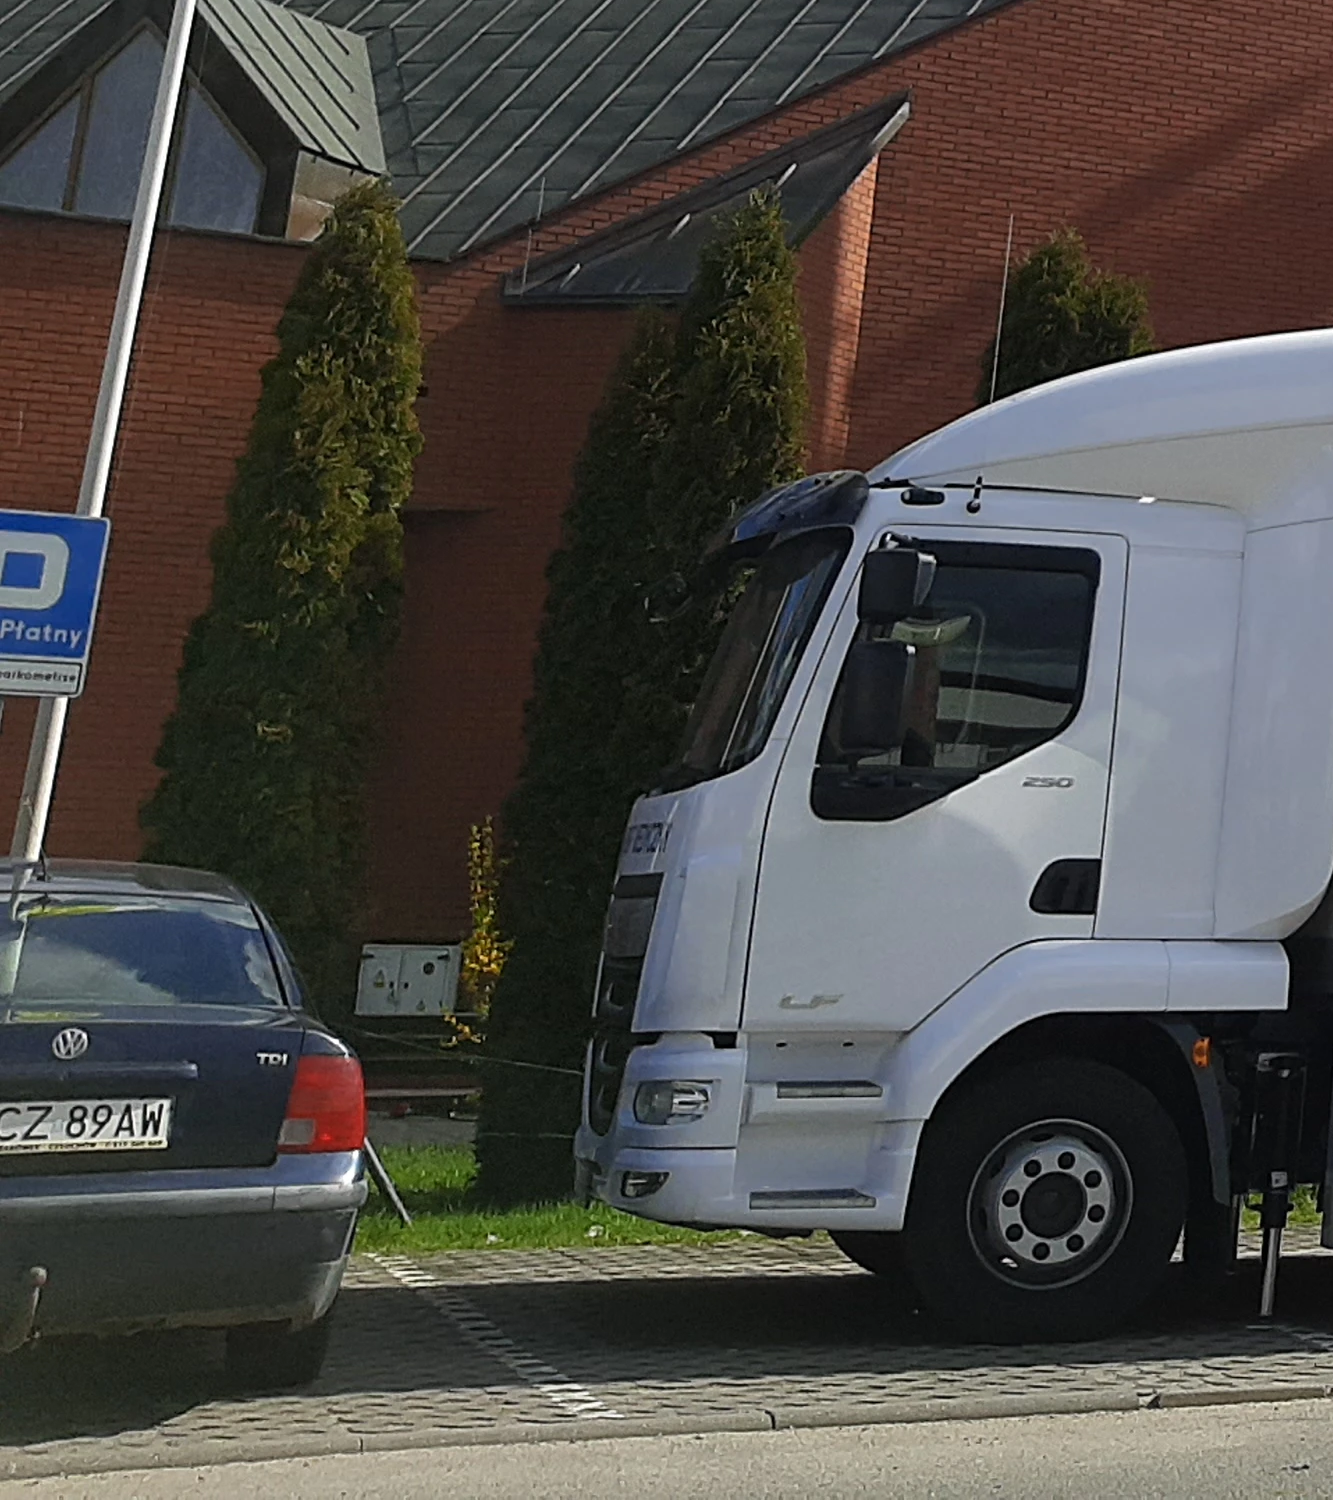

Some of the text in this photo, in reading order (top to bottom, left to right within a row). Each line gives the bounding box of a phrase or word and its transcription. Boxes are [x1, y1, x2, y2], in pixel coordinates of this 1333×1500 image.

[0, 618, 83, 649] Płatny
[1022, 776, 1074, 788] 250
[256, 1052, 288, 1066] TDI
[65, 1103, 164, 1139] 89AW
